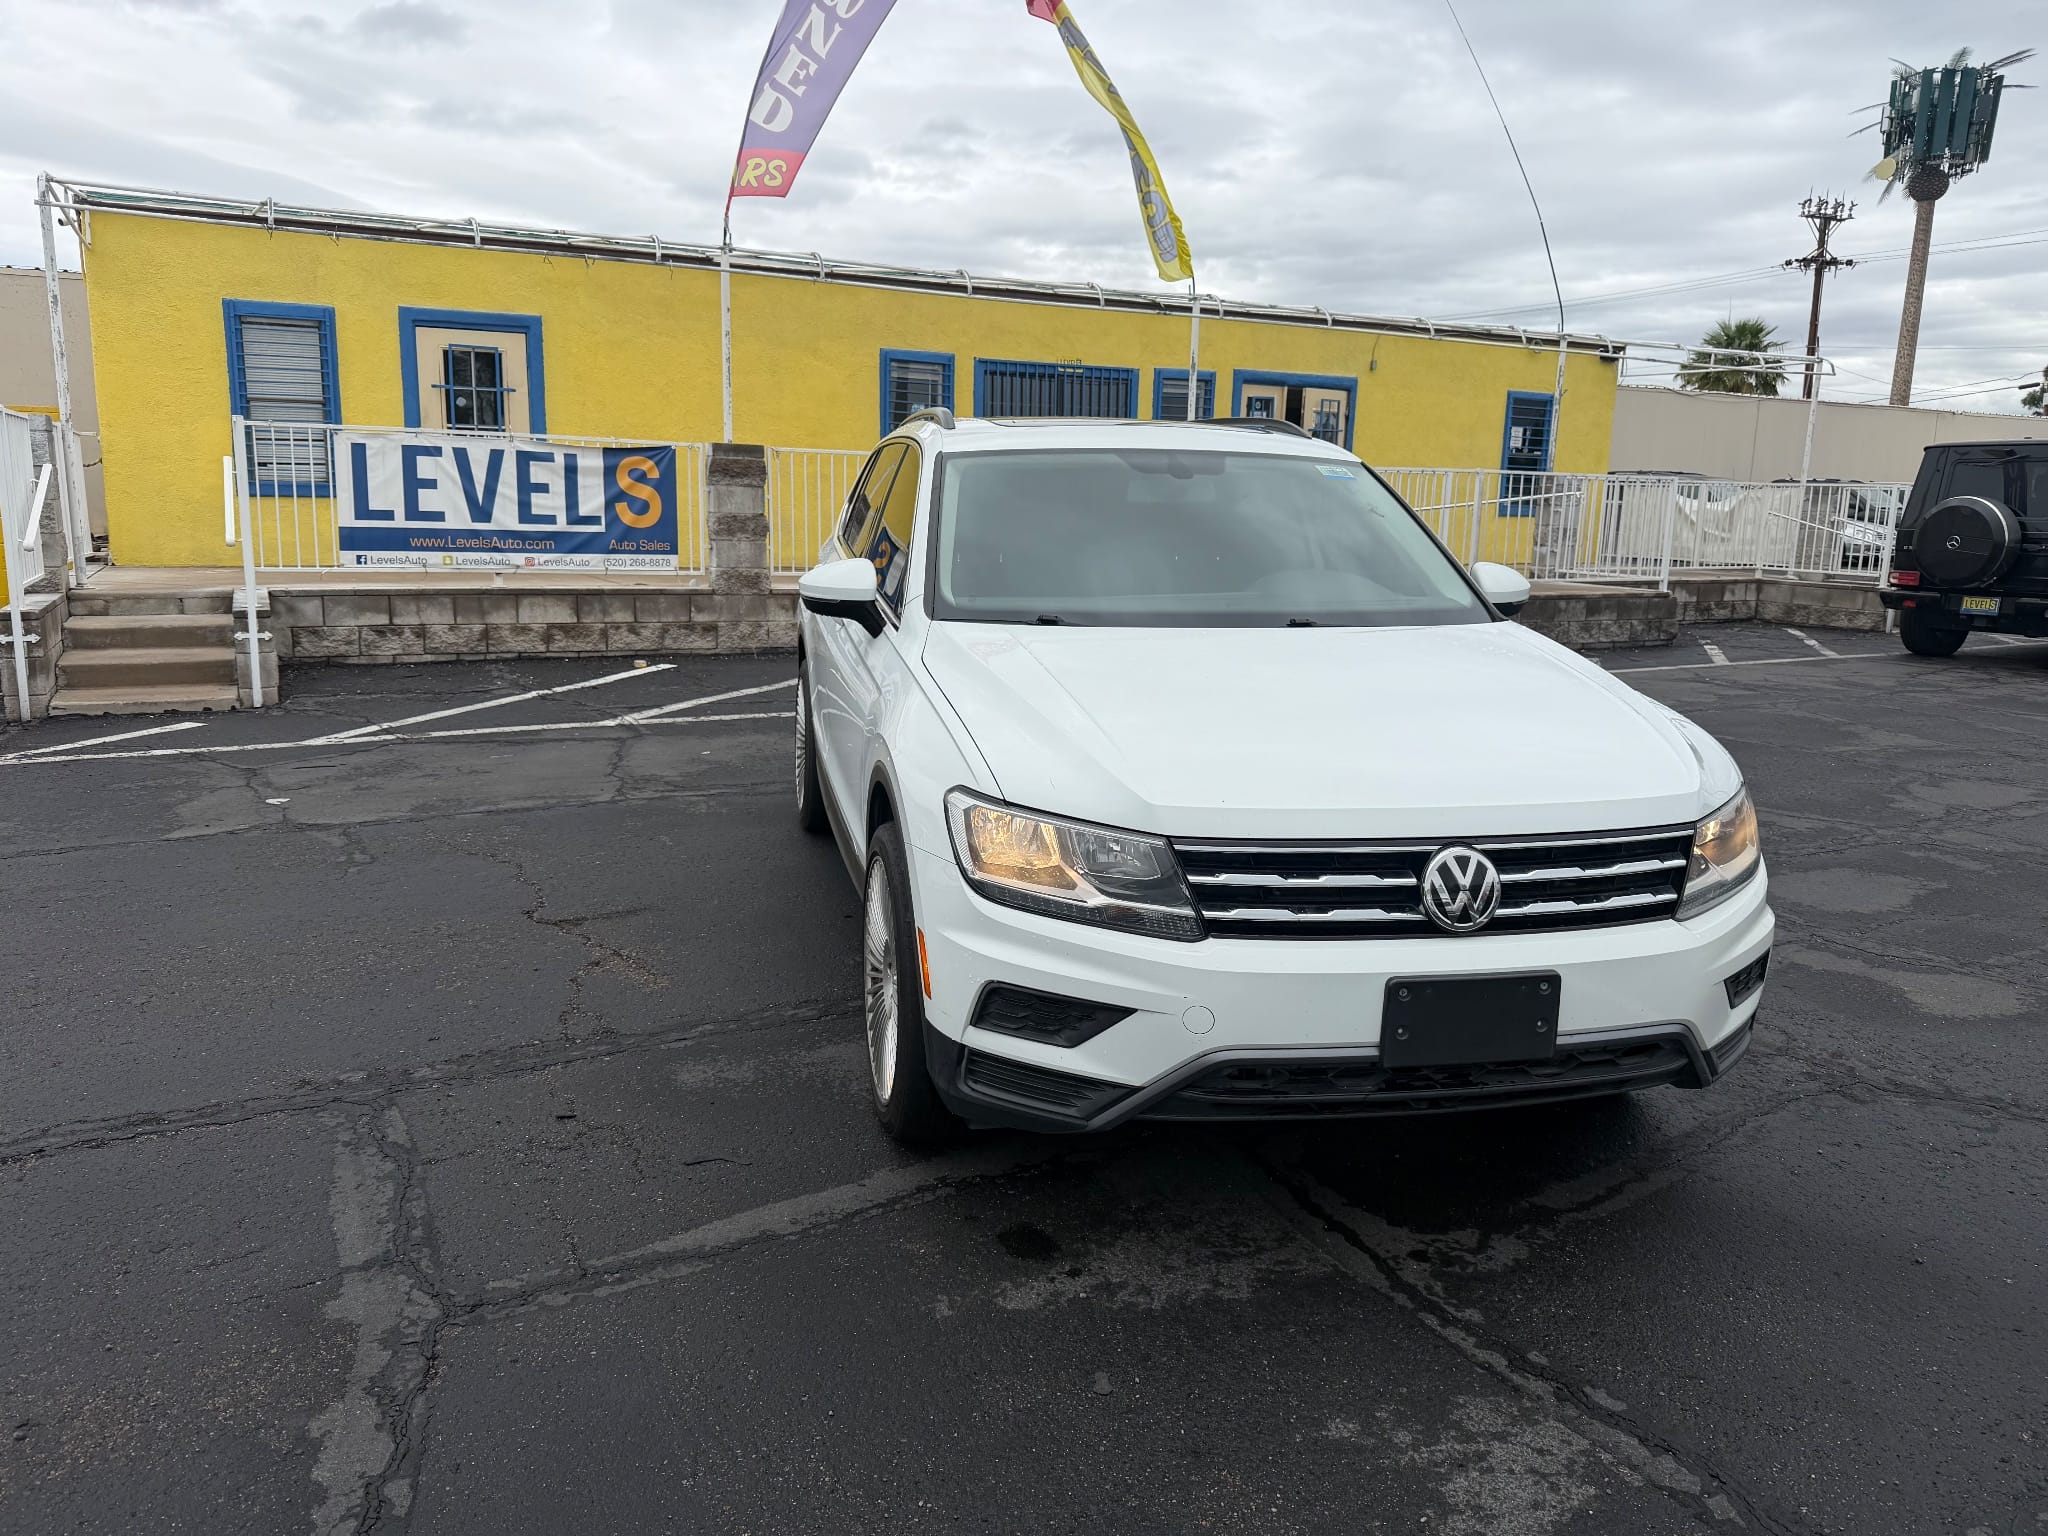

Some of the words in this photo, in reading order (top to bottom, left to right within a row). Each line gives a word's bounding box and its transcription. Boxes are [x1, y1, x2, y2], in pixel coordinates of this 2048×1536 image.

[734, 158, 787, 188] RS
[351, 442, 662, 528] LEVELS
[410, 535, 555, 550] www.LevelsAuto.com
[609, 539, 637, 550] Auto
[639, 540, 671, 551] Sales
[370, 555, 428, 565] LevelsAuto
[456, 556, 511, 566] LevelsAuto
[537, 557, 590, 567] LevelsAuto
[603, 558, 627, 568] (520)
[629, 558, 671, 567] 268-8878
[1965, 599, 1996, 610] LEVELS
